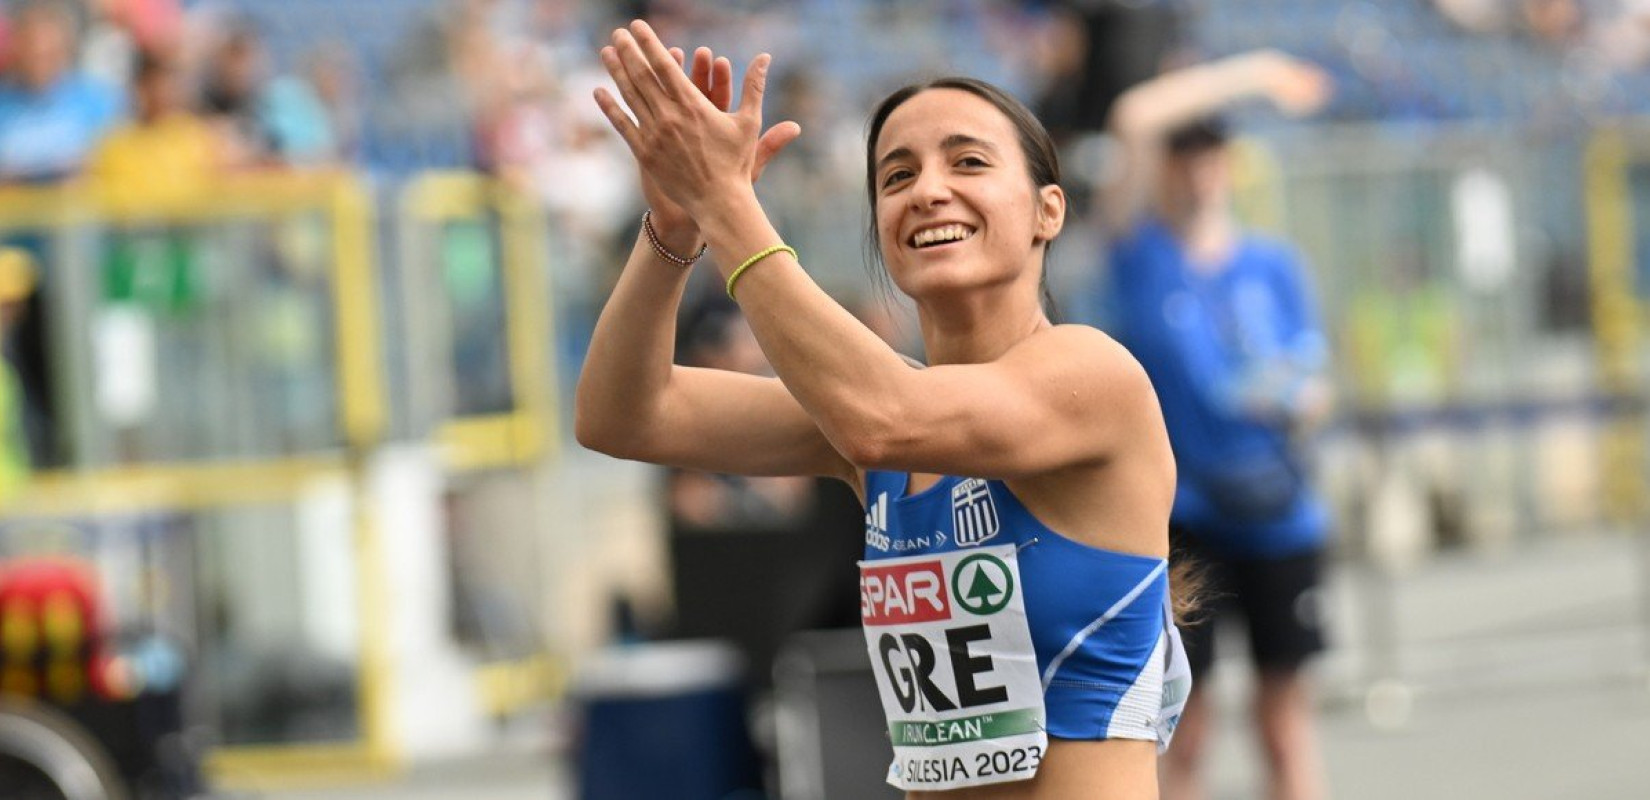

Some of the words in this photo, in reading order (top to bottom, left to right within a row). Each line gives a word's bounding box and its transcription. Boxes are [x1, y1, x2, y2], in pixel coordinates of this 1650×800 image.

[860, 570, 944, 617] SPAR
[879, 623, 1009, 713] GRE
[906, 757, 970, 783] SILESIA
[975, 745, 1042, 776] 2023
